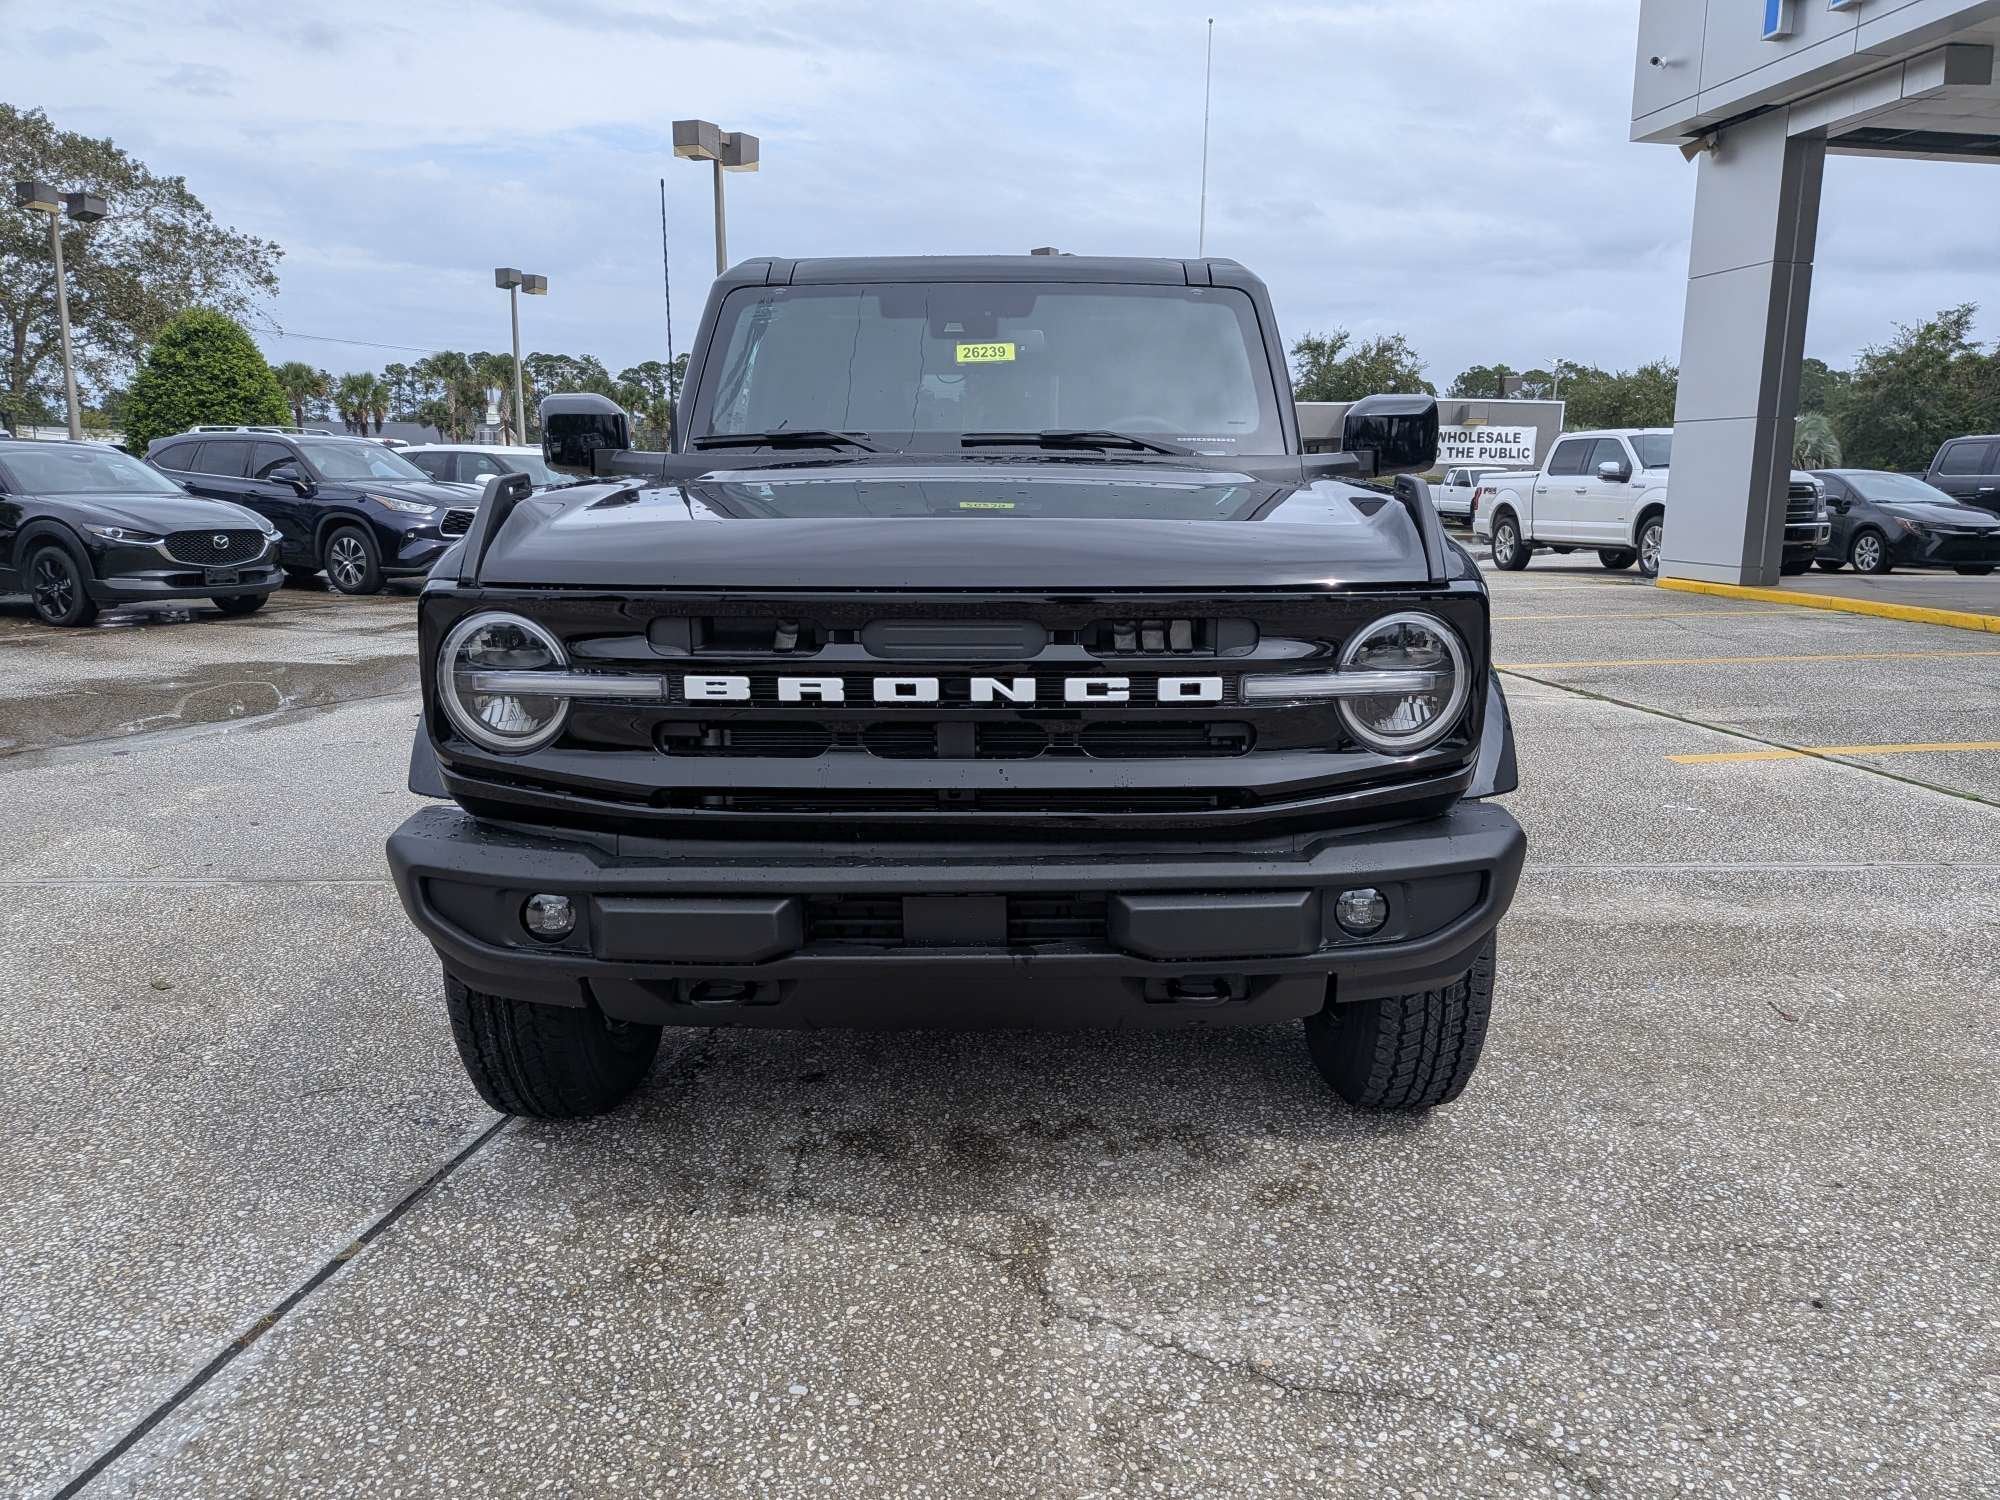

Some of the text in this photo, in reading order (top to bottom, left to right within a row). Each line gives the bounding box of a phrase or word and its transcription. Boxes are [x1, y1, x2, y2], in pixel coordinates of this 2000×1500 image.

[963, 346, 1006, 358] 26239
[1438, 431, 1522, 444] WHOLESALE
[1446, 446, 1475, 459] THE
[1479, 447, 1531, 460] PUBLIC
[684, 675, 1223, 702] BRONCO
